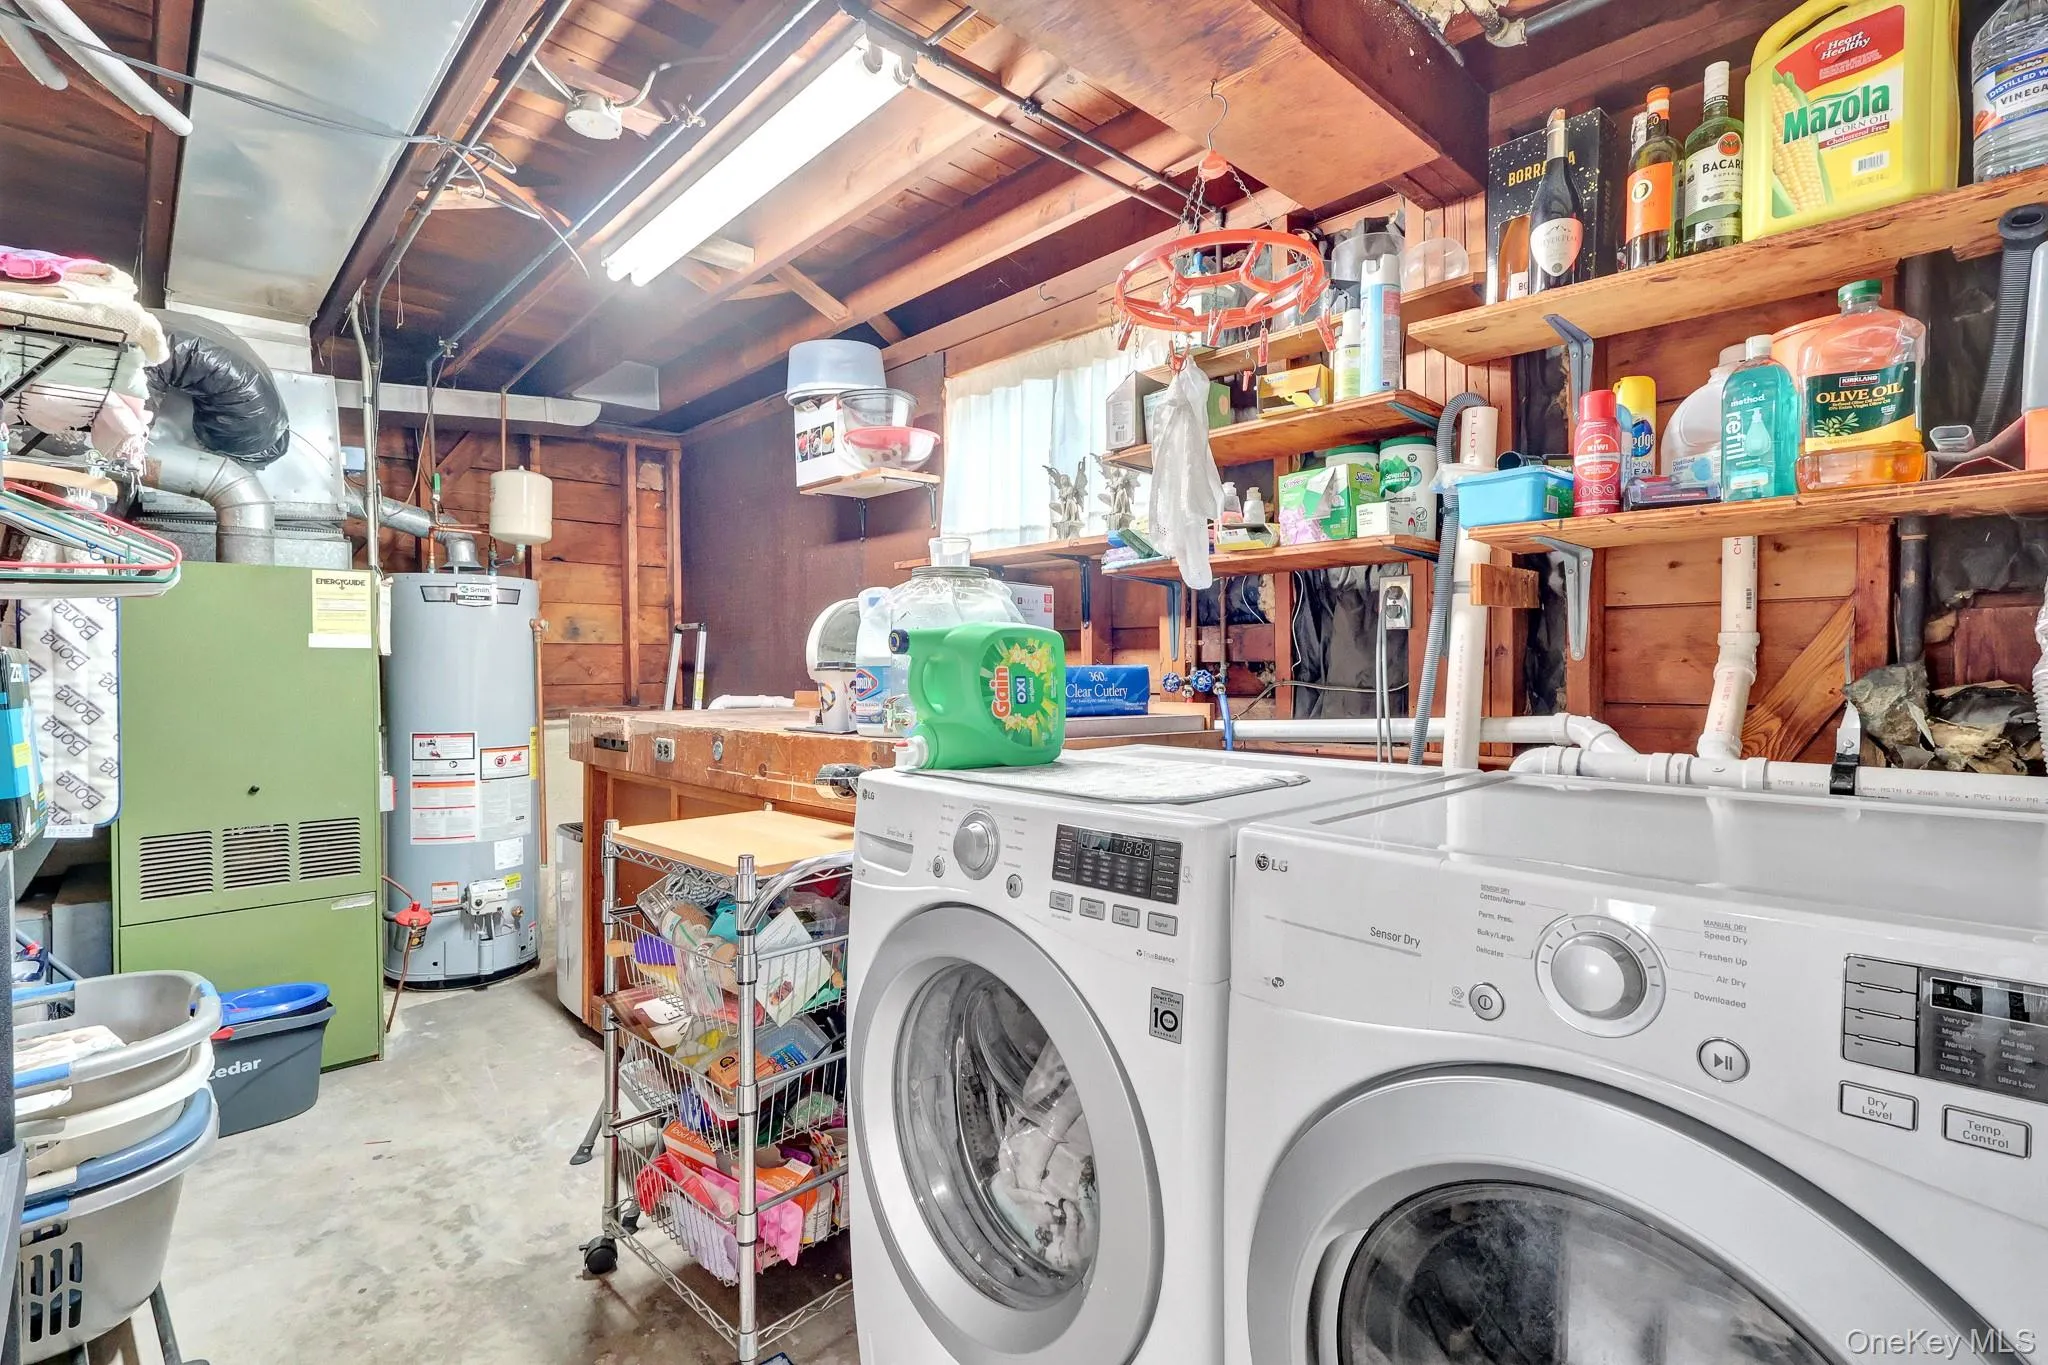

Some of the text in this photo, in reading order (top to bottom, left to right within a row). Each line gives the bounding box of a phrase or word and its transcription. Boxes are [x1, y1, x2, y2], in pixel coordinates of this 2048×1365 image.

[1828, 31, 1864, 50] Heart
[1820, 37, 1871, 61] Healthy
[1988, 72, 2037, 100] DISTILLED
[1783, 84, 1891, 145] Mazola
[1834, 113, 1890, 136] CORN OIL
[1826, 128, 1869, 147] Cholesterol
[1870, 124, 1888, 134] Free
[1841, 375, 1878, 384] KIRKLAND
[1815, 382, 1905, 404] OLIVE OIL
[1731, 394, 1766, 408] method
[1725, 410, 1748, 461] refill
[1586, 443, 1609, 452] KIWI
[1384, 471, 1410, 481] Seventh
[315, 577, 366, 587] ENERGYGUIDE
[53, 600, 100, 641] Bona
[40, 630, 88, 672] Bona
[1088, 671, 1105, 682] 360
[989, 665, 1012, 719] Gain
[1016, 677, 1027, 703] OXI
[1065, 683, 1092, 698] Clear
[1094, 683, 1128, 700] Cutlery
[55, 686, 101, 726] Bona
[41, 716, 89, 757] Bona
[55, 771, 102, 811] Bona
[867, 791, 875, 800] LG
[1271, 858, 1288, 873] LG
[1479, 892, 1526, 906] Cotton/Normal
[1703, 919, 1747, 932] MANUAL DRY
[1370, 926, 1421, 949] Sensor Dry
[1477, 928, 1515, 943] Bulky/Large
[1704, 930, 1748, 945] Speed Dry
[1475, 945, 1504, 958] Delicates
[1699, 951, 1748, 967] Freshen Up
[1716, 975, 1747, 989] Air Dry
[1153, 993, 1167, 1002] Direct
[1694, 991, 1747, 1009] Downloaded
[1153, 1006, 1179, 1033] 10
[1942, 1015, 1975, 1027] Very Dry
[2008, 1027, 2026, 1037] High
[1960, 1055, 1974, 1065] Dry
[2002, 1051, 2033, 1063] Medium
[1940, 1063, 1976, 1078] Damp Dry
[2008, 1065, 2026, 1075] Low
[1997, 1075, 2036, 1089] Ultra Low
[1867, 1096, 1888, 1110] Dry
[1861, 1105, 1893, 1121] Level
[1967, 1119, 2006, 1138] Temp.
[1962, 1130, 2010, 1150] Control
